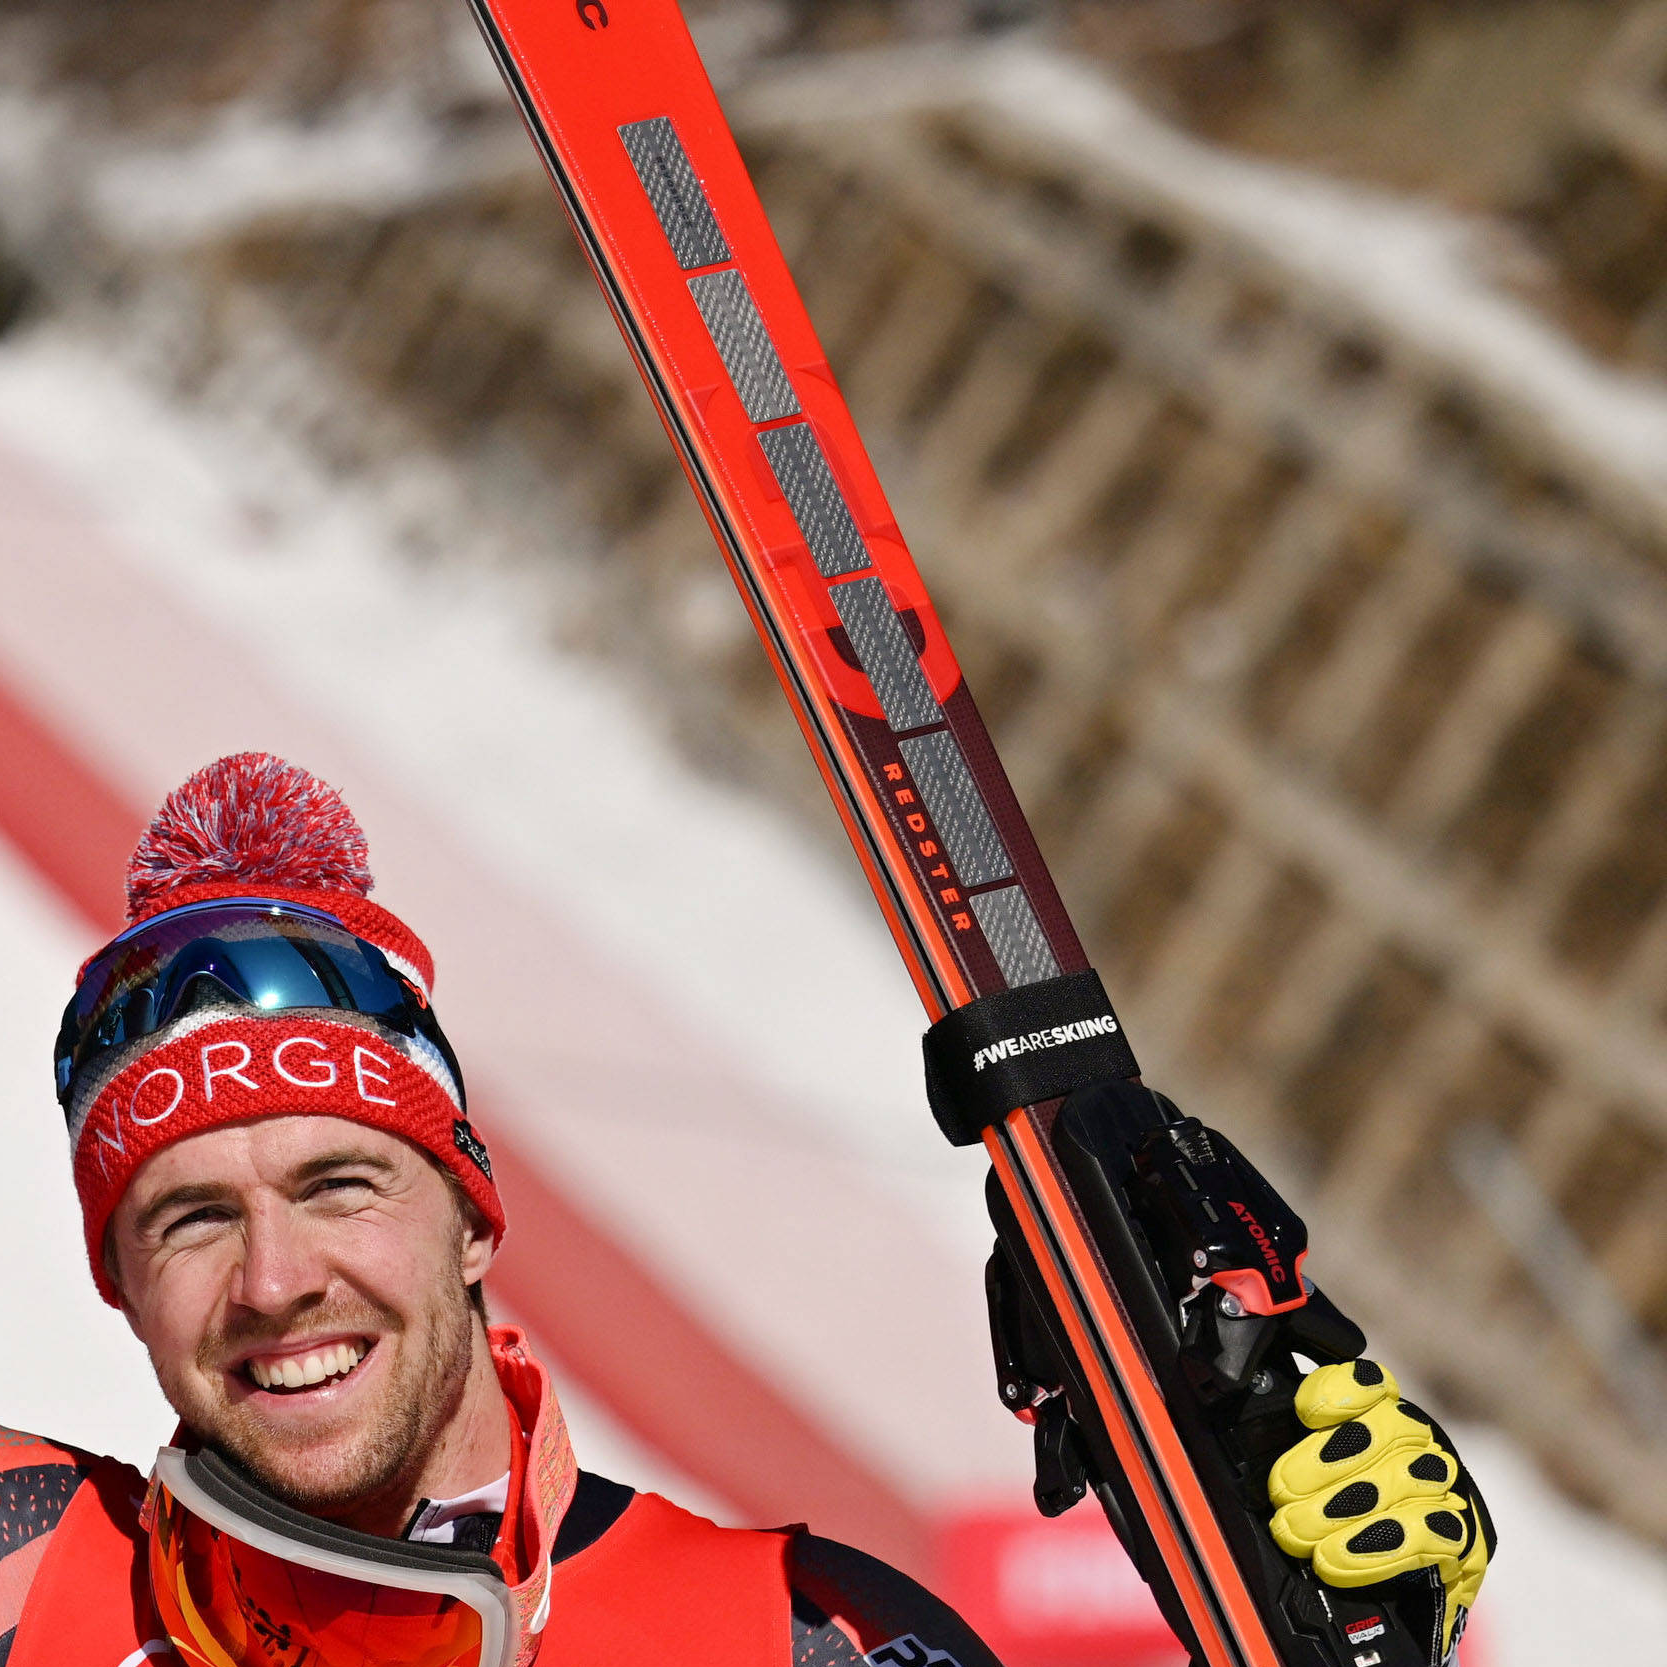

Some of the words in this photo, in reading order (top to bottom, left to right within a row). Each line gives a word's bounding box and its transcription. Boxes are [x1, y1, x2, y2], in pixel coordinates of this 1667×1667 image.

[883, 762, 972, 934] REDSTER
[973, 1015, 1118, 1072] #WEARESKIING
[92, 1036, 398, 1181] NORGE
[1227, 1201, 1287, 1284] ATOMIC
[1345, 1616, 1381, 1634] GRIP
[1349, 1625, 1382, 1642] WALK
